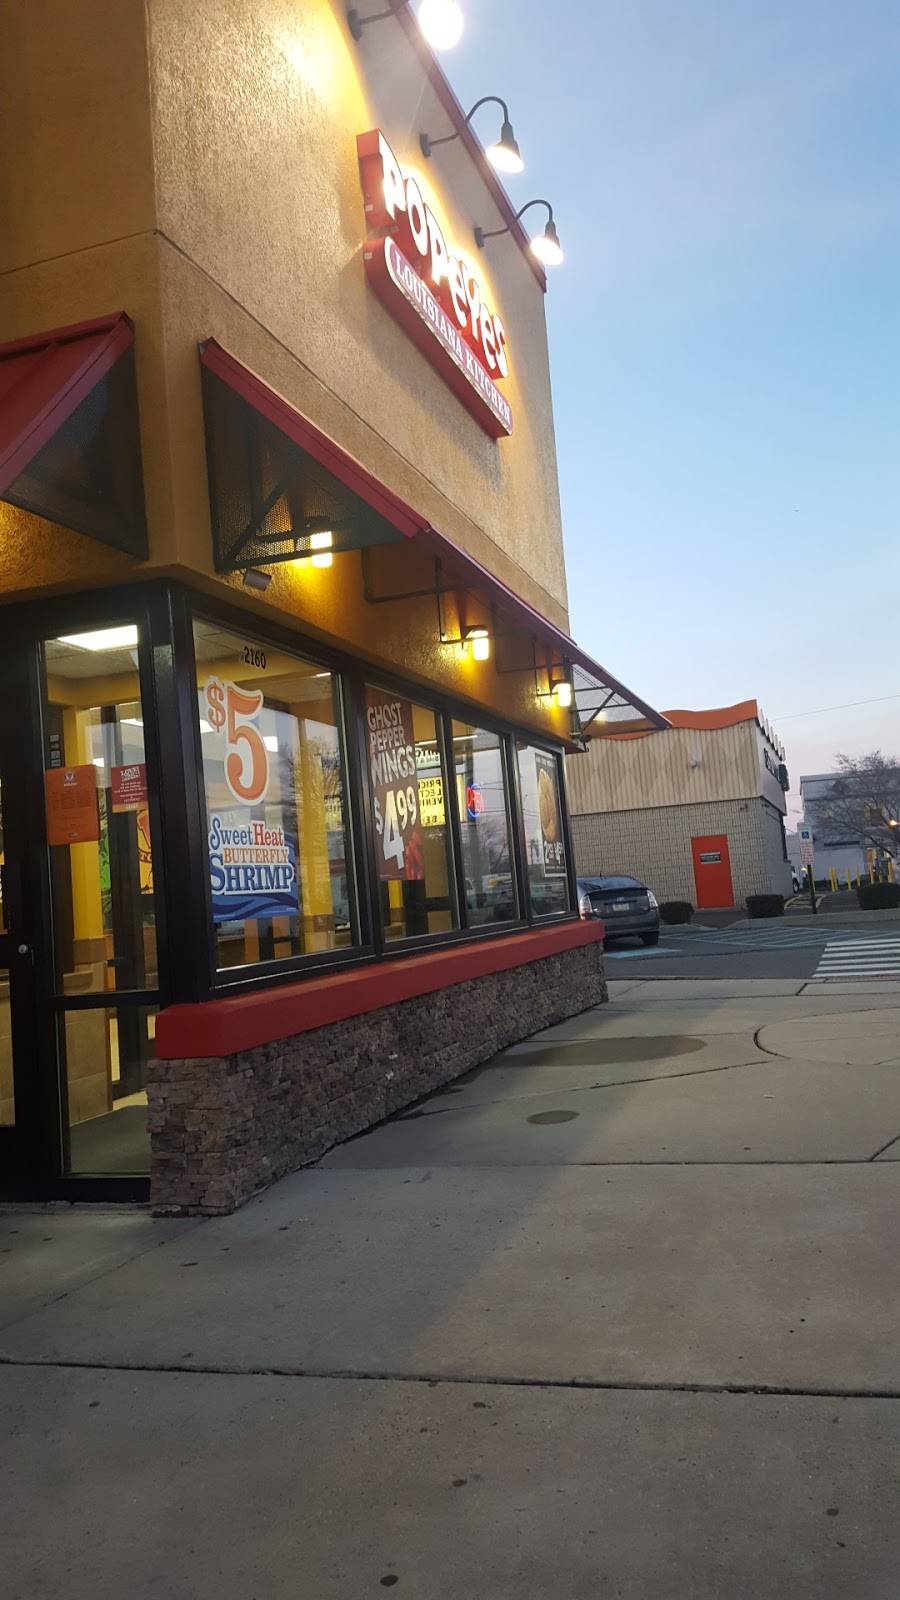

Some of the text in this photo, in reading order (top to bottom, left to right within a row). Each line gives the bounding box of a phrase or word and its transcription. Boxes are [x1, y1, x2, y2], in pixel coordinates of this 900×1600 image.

[393, 250, 512, 425] LOUISIANA KITCHEN
[244, 645, 267, 670] 2160
[367, 702, 402, 731] GHOST
[370, 725, 406, 752] PEPPER
[370, 745, 416, 789] WINGS
[224, 848, 288, 864] BUTTERFLY
[210, 853, 293, 892] SHRIMP
